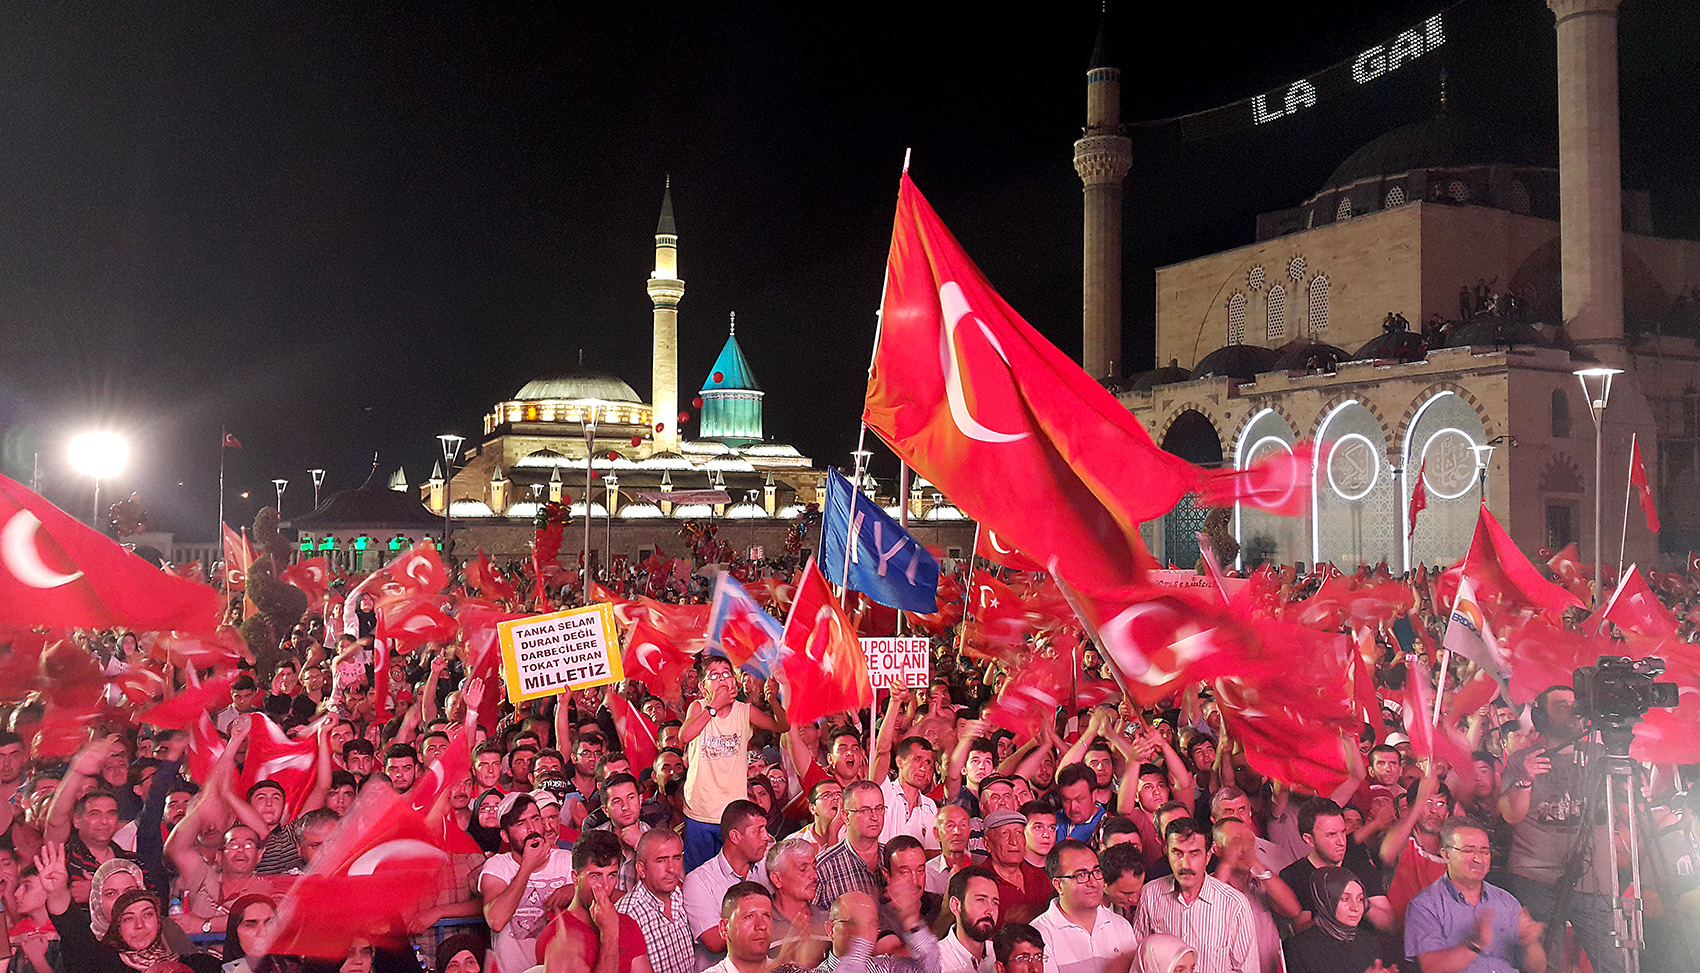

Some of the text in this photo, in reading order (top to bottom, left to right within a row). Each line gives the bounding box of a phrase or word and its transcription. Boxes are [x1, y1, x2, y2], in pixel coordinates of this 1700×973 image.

[516, 617, 595, 639] TANKA SELAM
[520, 628, 596, 650] DURAN DEĞİL
[871, 638, 927, 653] POLİSLER
[520, 640, 598, 661] DARBECİLERE
[521, 651, 602, 673] TOKAT VURAN
[883, 653, 925, 670] OLANI
[524, 662, 606, 690] MİLLETİZ
[869, 671, 928, 687] ÜNER
